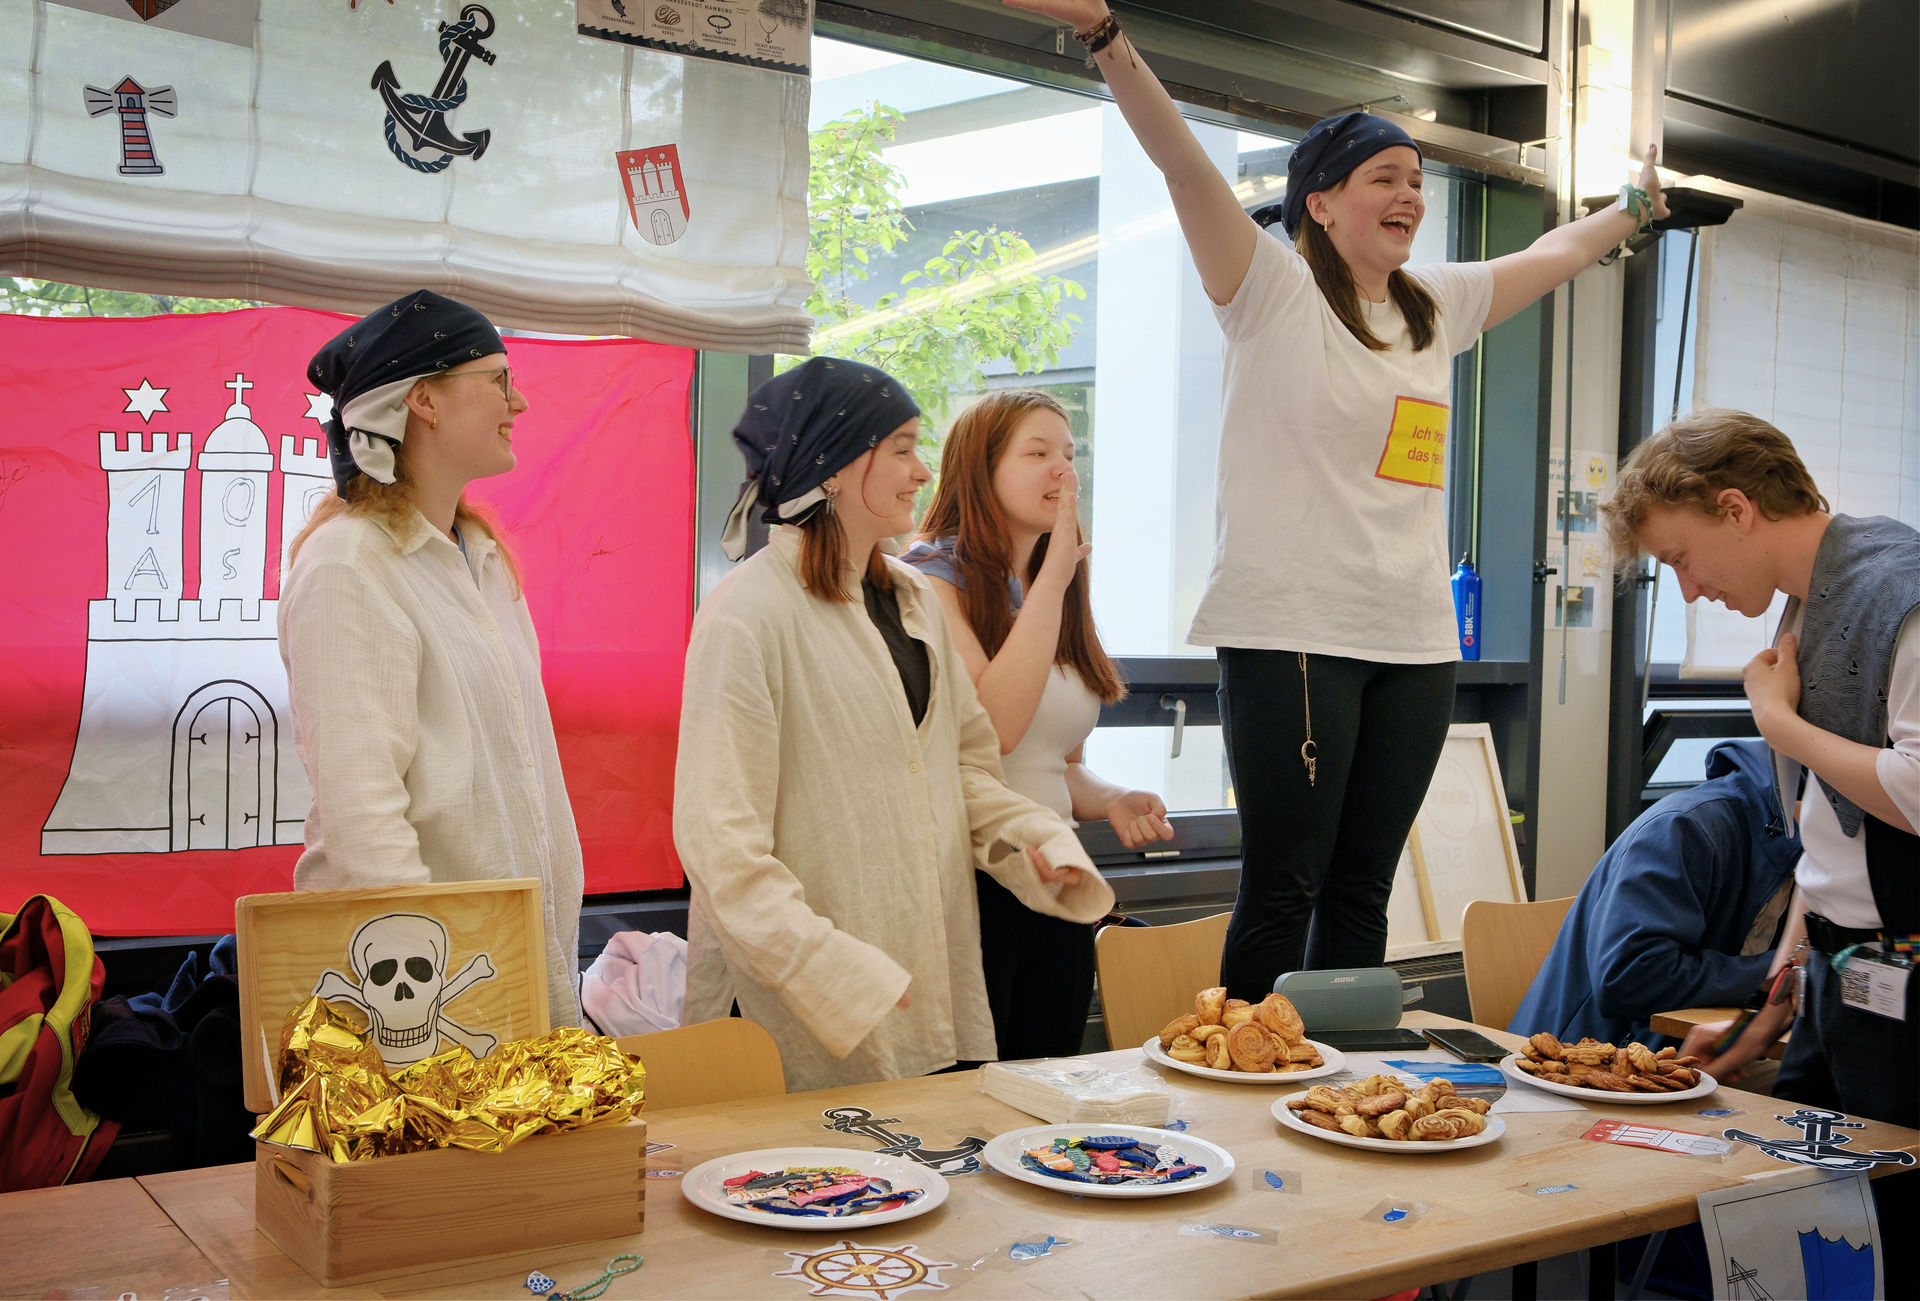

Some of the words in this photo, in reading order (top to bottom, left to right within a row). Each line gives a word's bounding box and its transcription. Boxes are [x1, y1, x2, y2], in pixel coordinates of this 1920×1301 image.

[704, 4, 733, 14] HAMBURG
[1411, 424, 1432, 441] Ich
[1407, 446, 1429, 463] das
[1464, 616, 1475, 635] BBK
